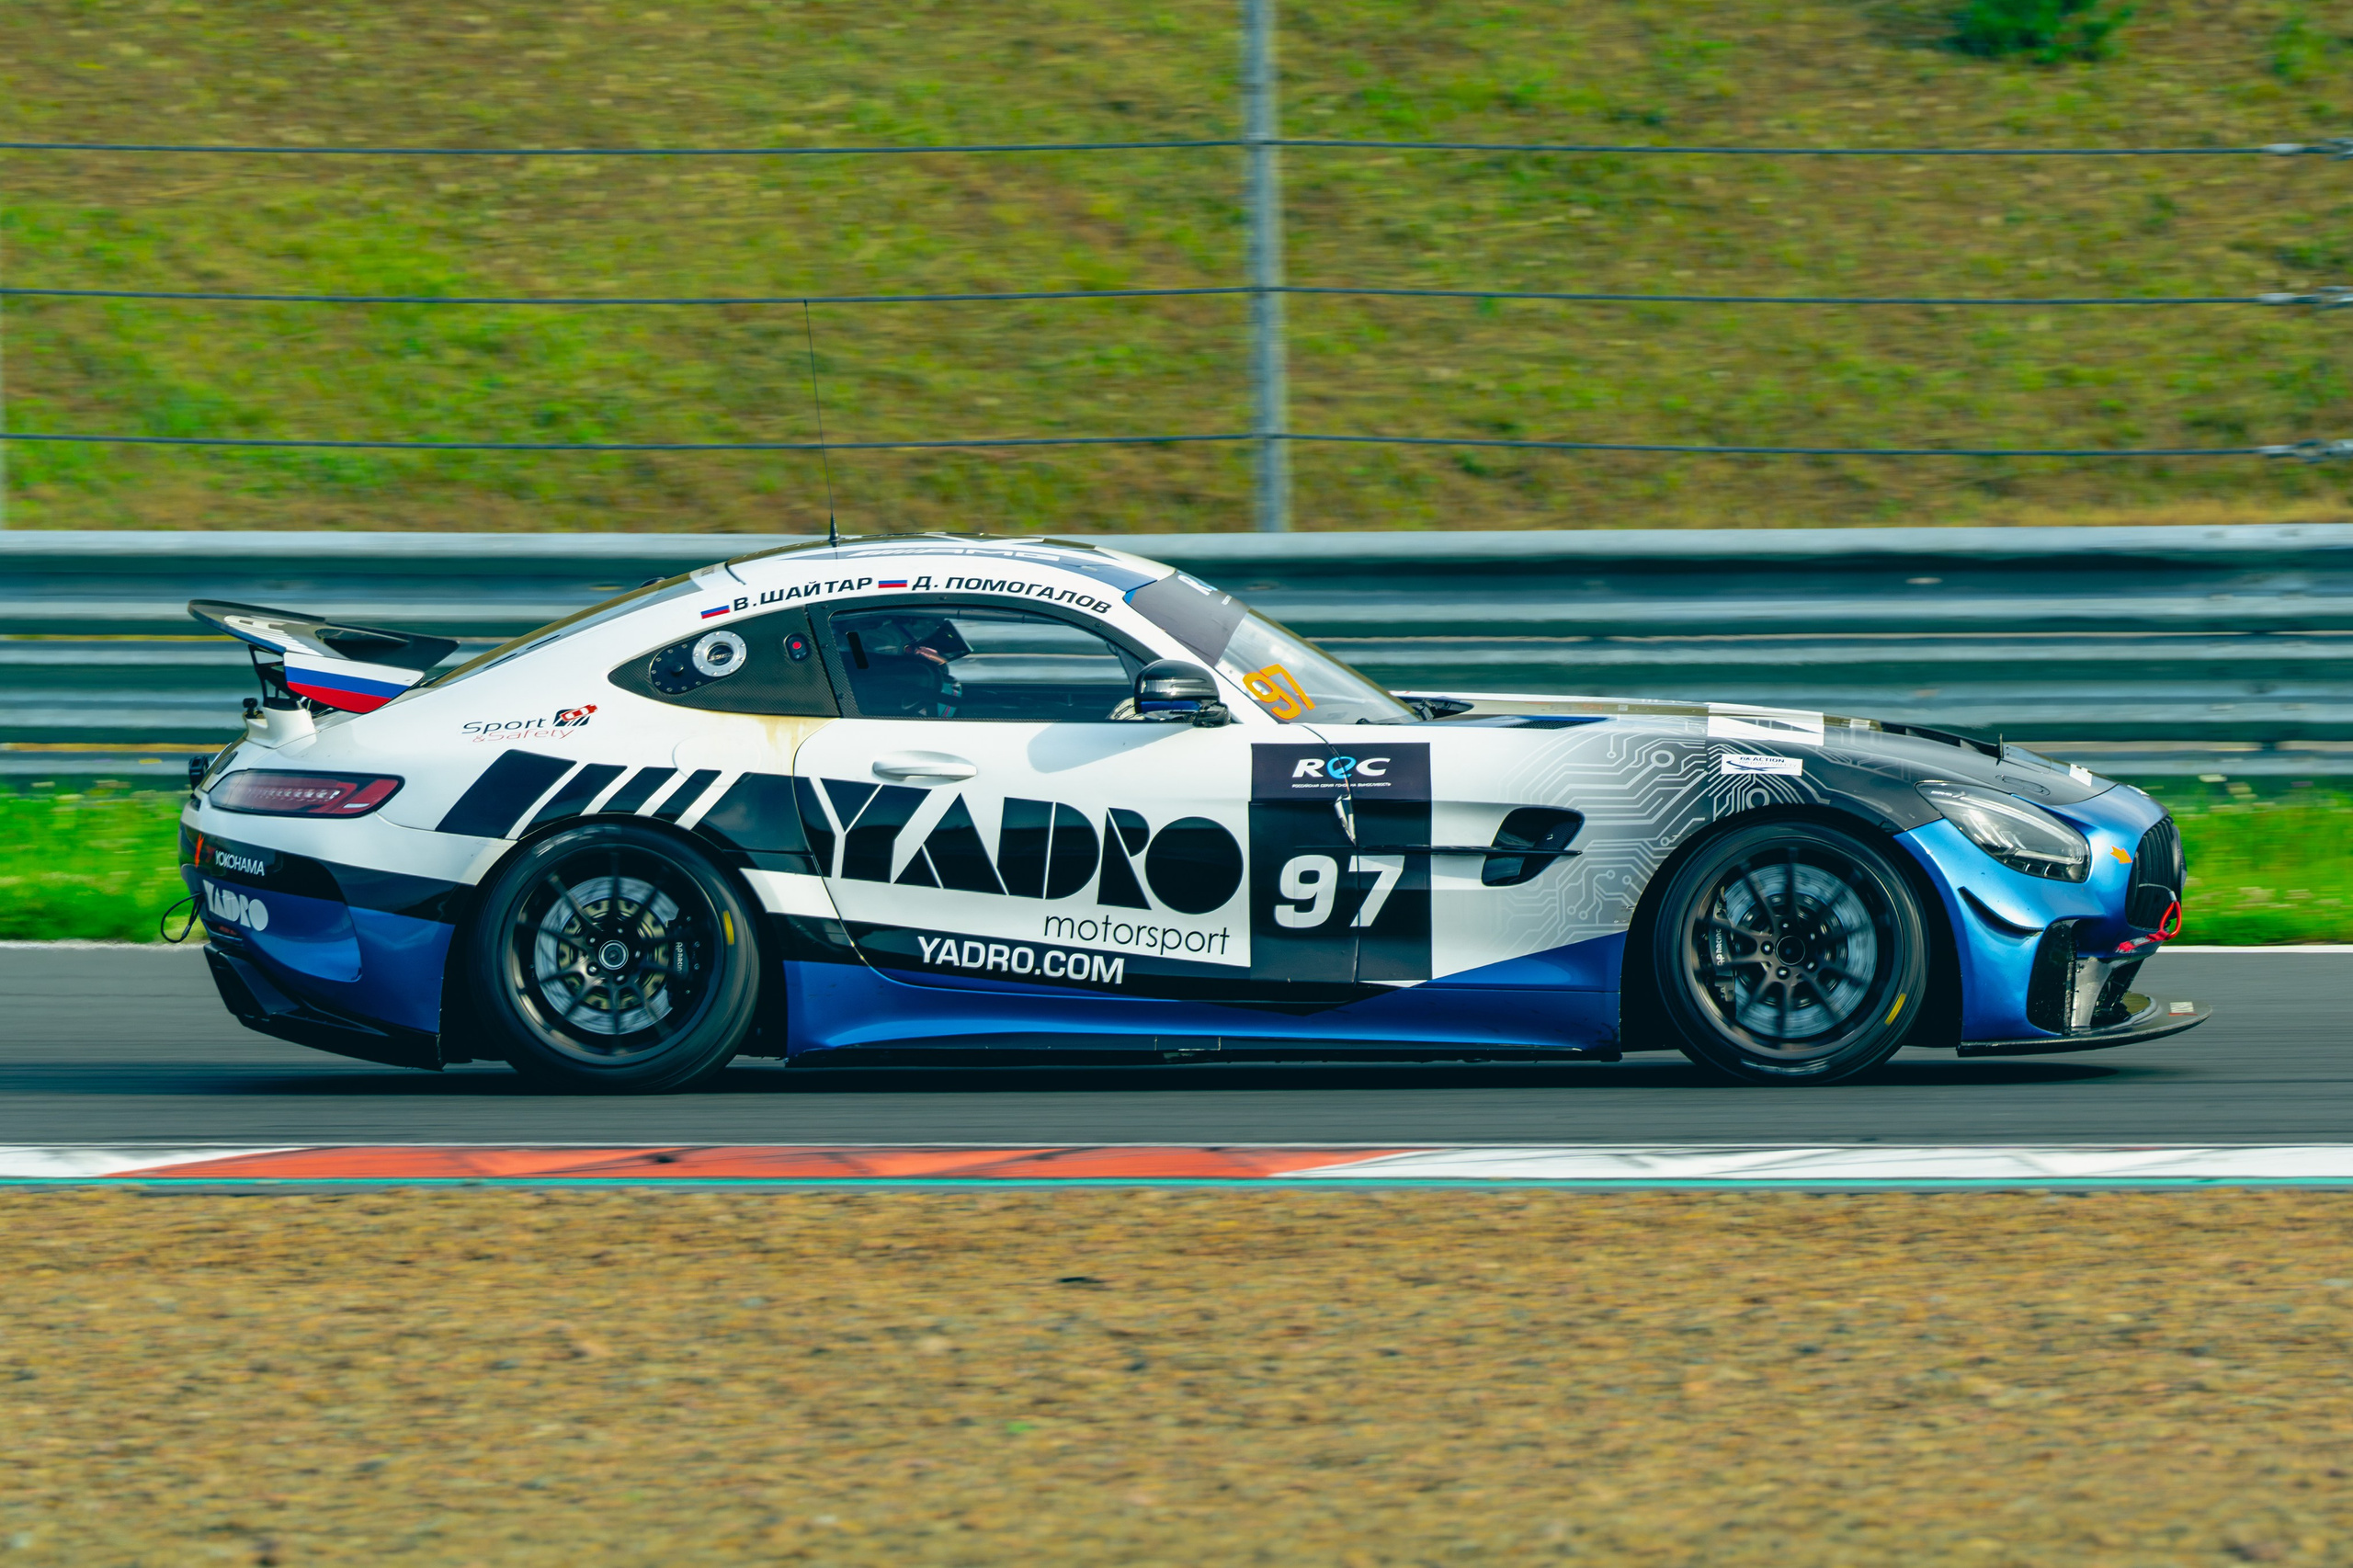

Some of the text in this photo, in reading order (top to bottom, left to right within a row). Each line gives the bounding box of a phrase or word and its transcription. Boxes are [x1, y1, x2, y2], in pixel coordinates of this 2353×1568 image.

[945, 576, 1112, 614] ПОМОГАЛОВ
[1242, 664, 1316, 720] 97
[461, 718, 547, 734] Sport
[215, 849, 265, 876] YOKOHAMA
[821, 778, 1245, 915] YADRO
[202, 879, 269, 932] YADRO
[1273, 853, 1405, 929] 97
[1043, 911, 1231, 957] motorsport
[917, 936, 1126, 985] YADRO.COM
